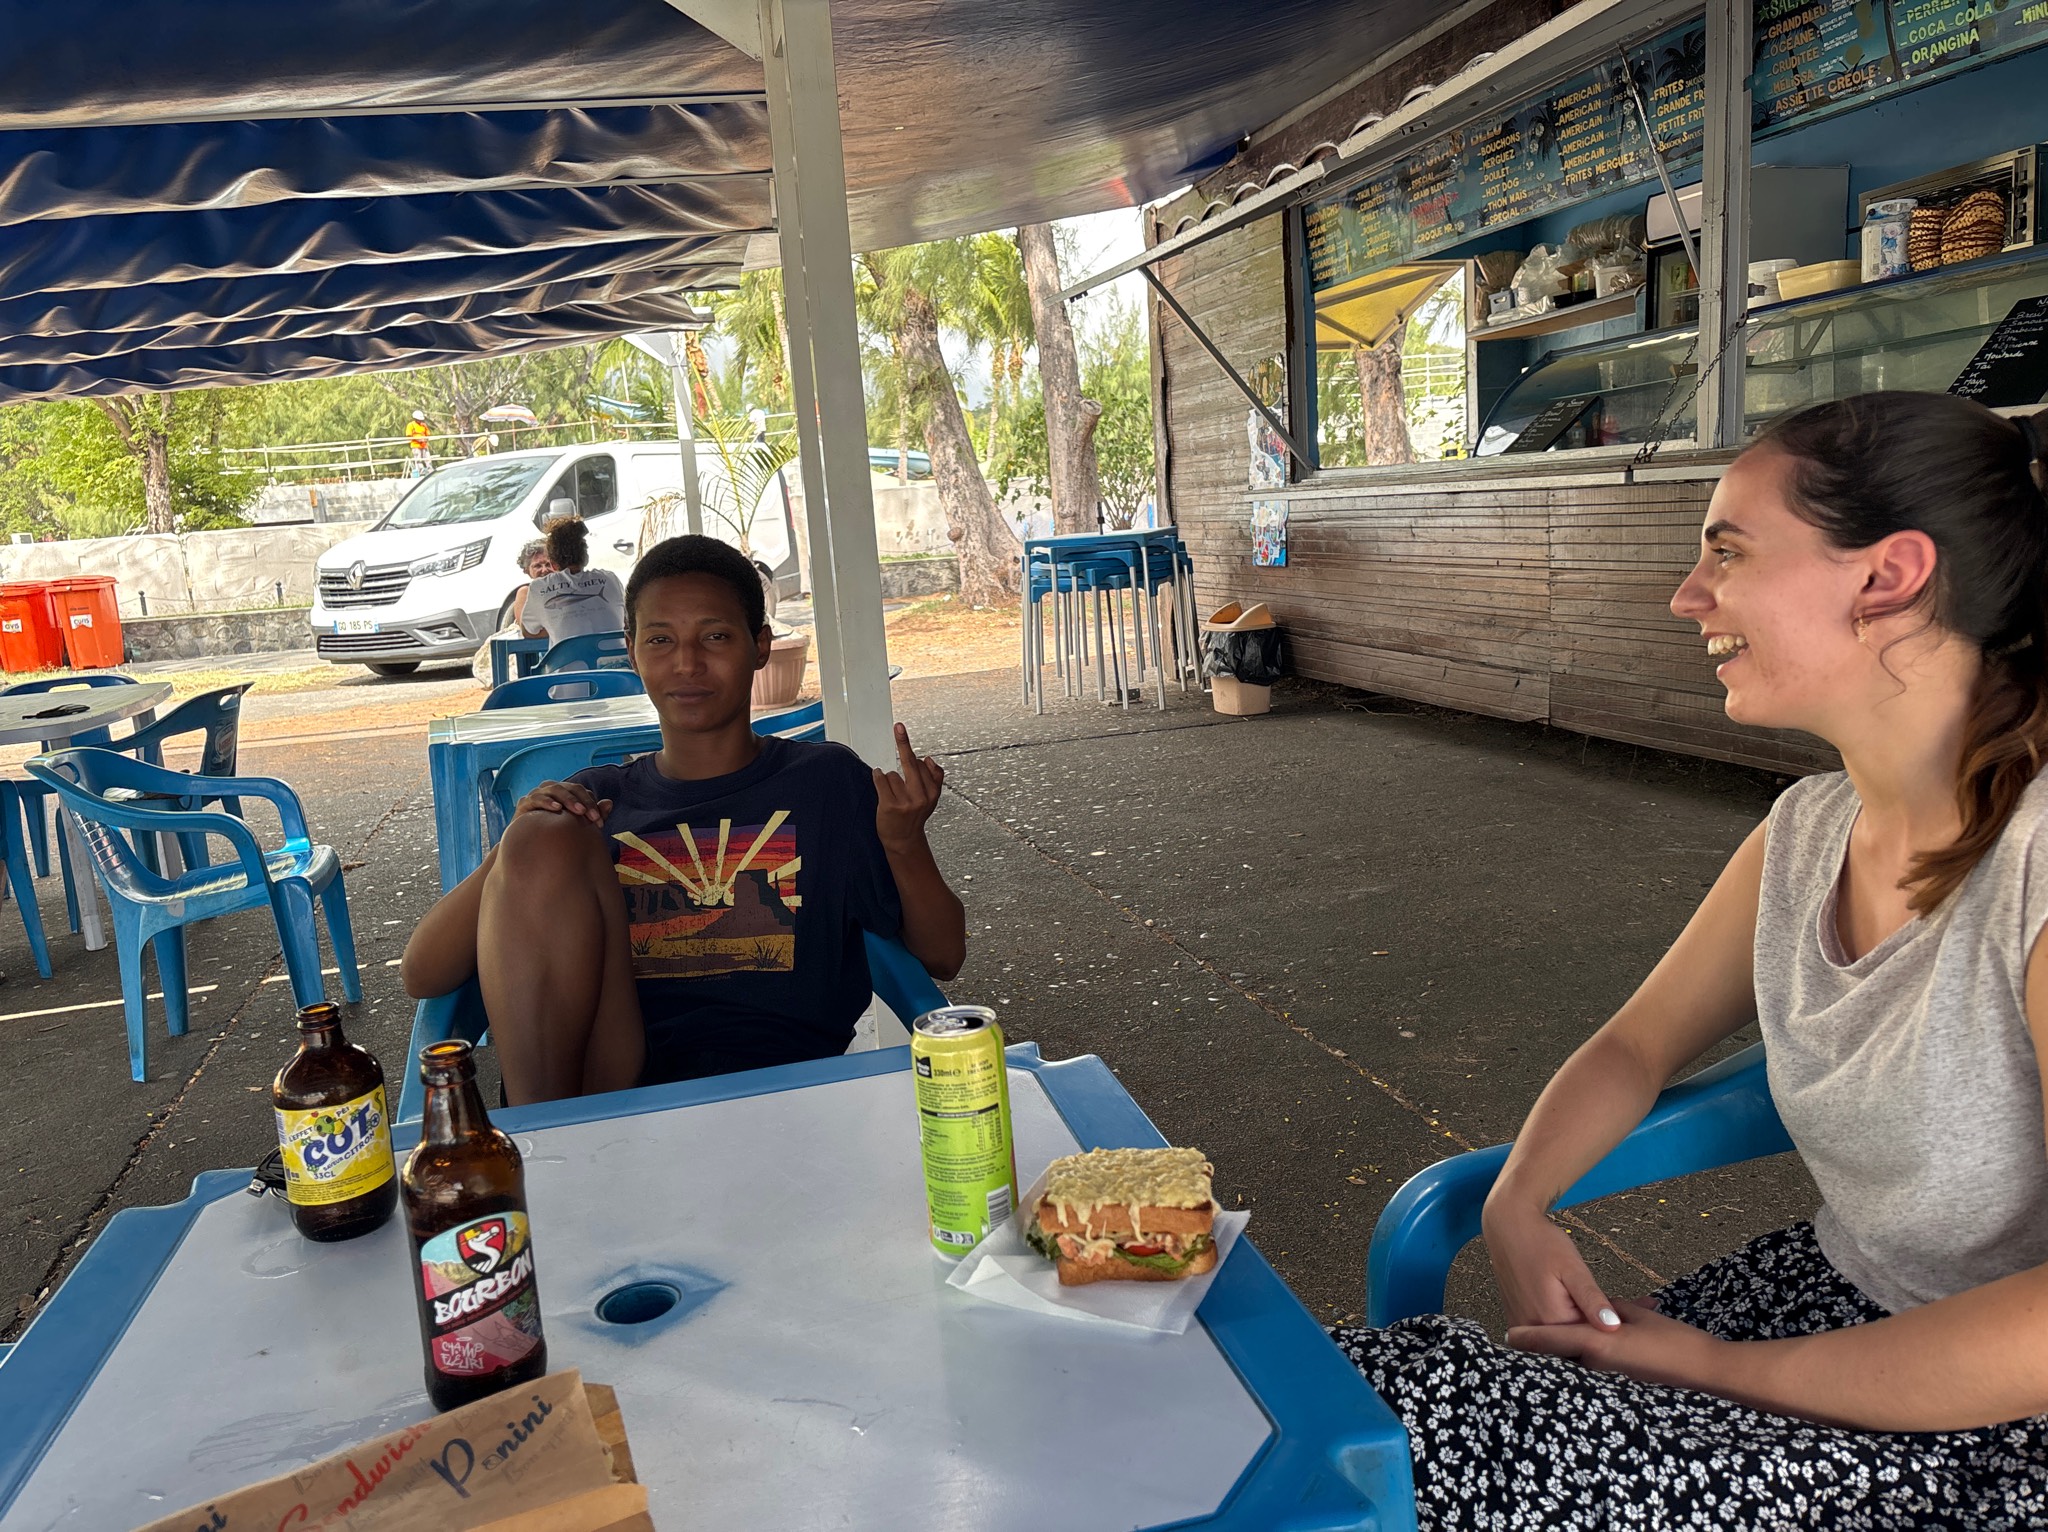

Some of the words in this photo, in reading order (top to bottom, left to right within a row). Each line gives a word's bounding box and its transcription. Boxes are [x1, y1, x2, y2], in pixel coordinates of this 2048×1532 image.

[1768, 15, 1802, 38] GRAND
[1802, 4, 1827, 25] BLEU
[1770, 28, 1815, 57] OCÉANE
[1657, 94, 1692, 117] GRANDE
[1481, 132, 1520, 157] BOUCHONS
[1483, 149, 1516, 169] MERGUEZ
[1484, 166, 1510, 182] POULET
[1485, 184, 1500, 197] HOT
[1502, 177, 1520, 191] DOG
[1488, 197, 1507, 210] THON
[540, 580, 571, 596] SALTY
[577, 578, 607, 588] CREW
[349, 620, 362, 631] 185
[322, 1156, 344, 1171] SAVEUR
[344, 1130, 375, 1160] CITRON
[313, 1171, 337, 1180] 33CL
[434, 1247, 533, 1325] BOURBON
[441, 1340, 485, 1359] CHAMP
[440, 1352, 485, 1370] FLEURI
[429, 1395, 553, 1499] Panini
